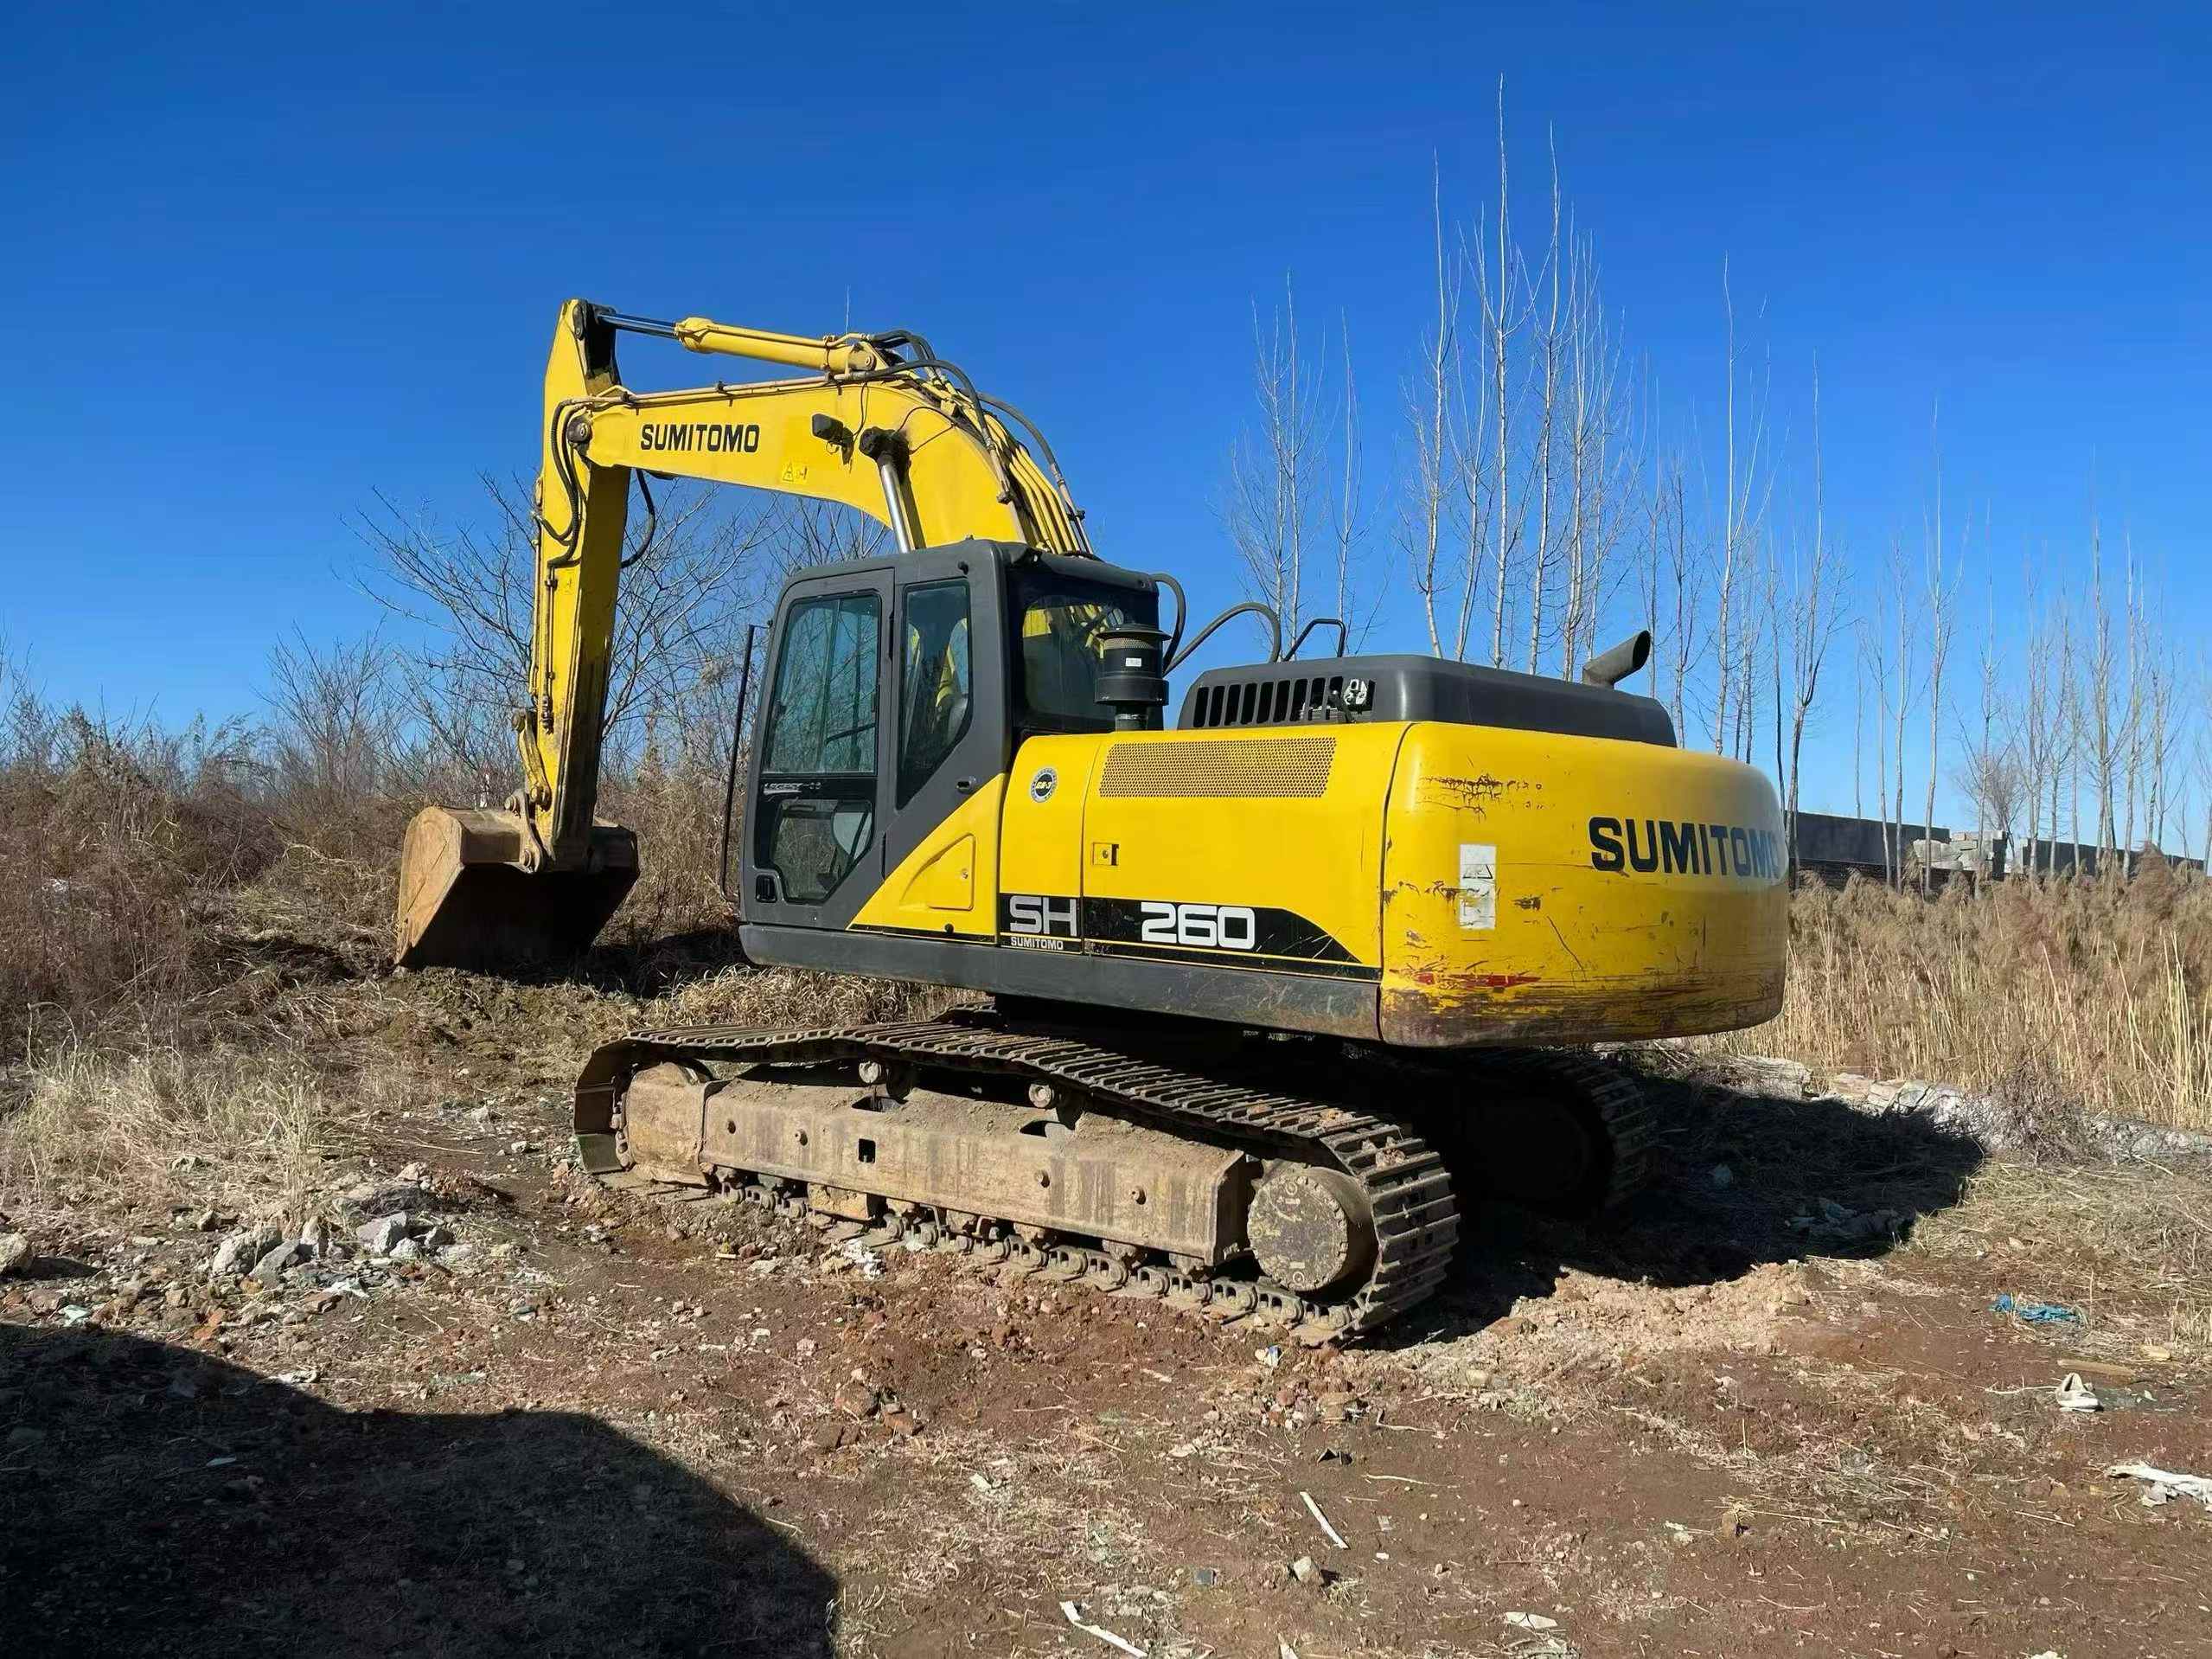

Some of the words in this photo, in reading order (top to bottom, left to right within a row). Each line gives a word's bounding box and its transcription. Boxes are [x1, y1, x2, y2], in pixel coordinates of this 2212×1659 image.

[640, 424, 760, 453] SUMITOMO
[1009, 894, 1077, 937] SH
[1141, 901, 1256, 950] 260
[1010, 936, 1064, 951] SUMITOMO
